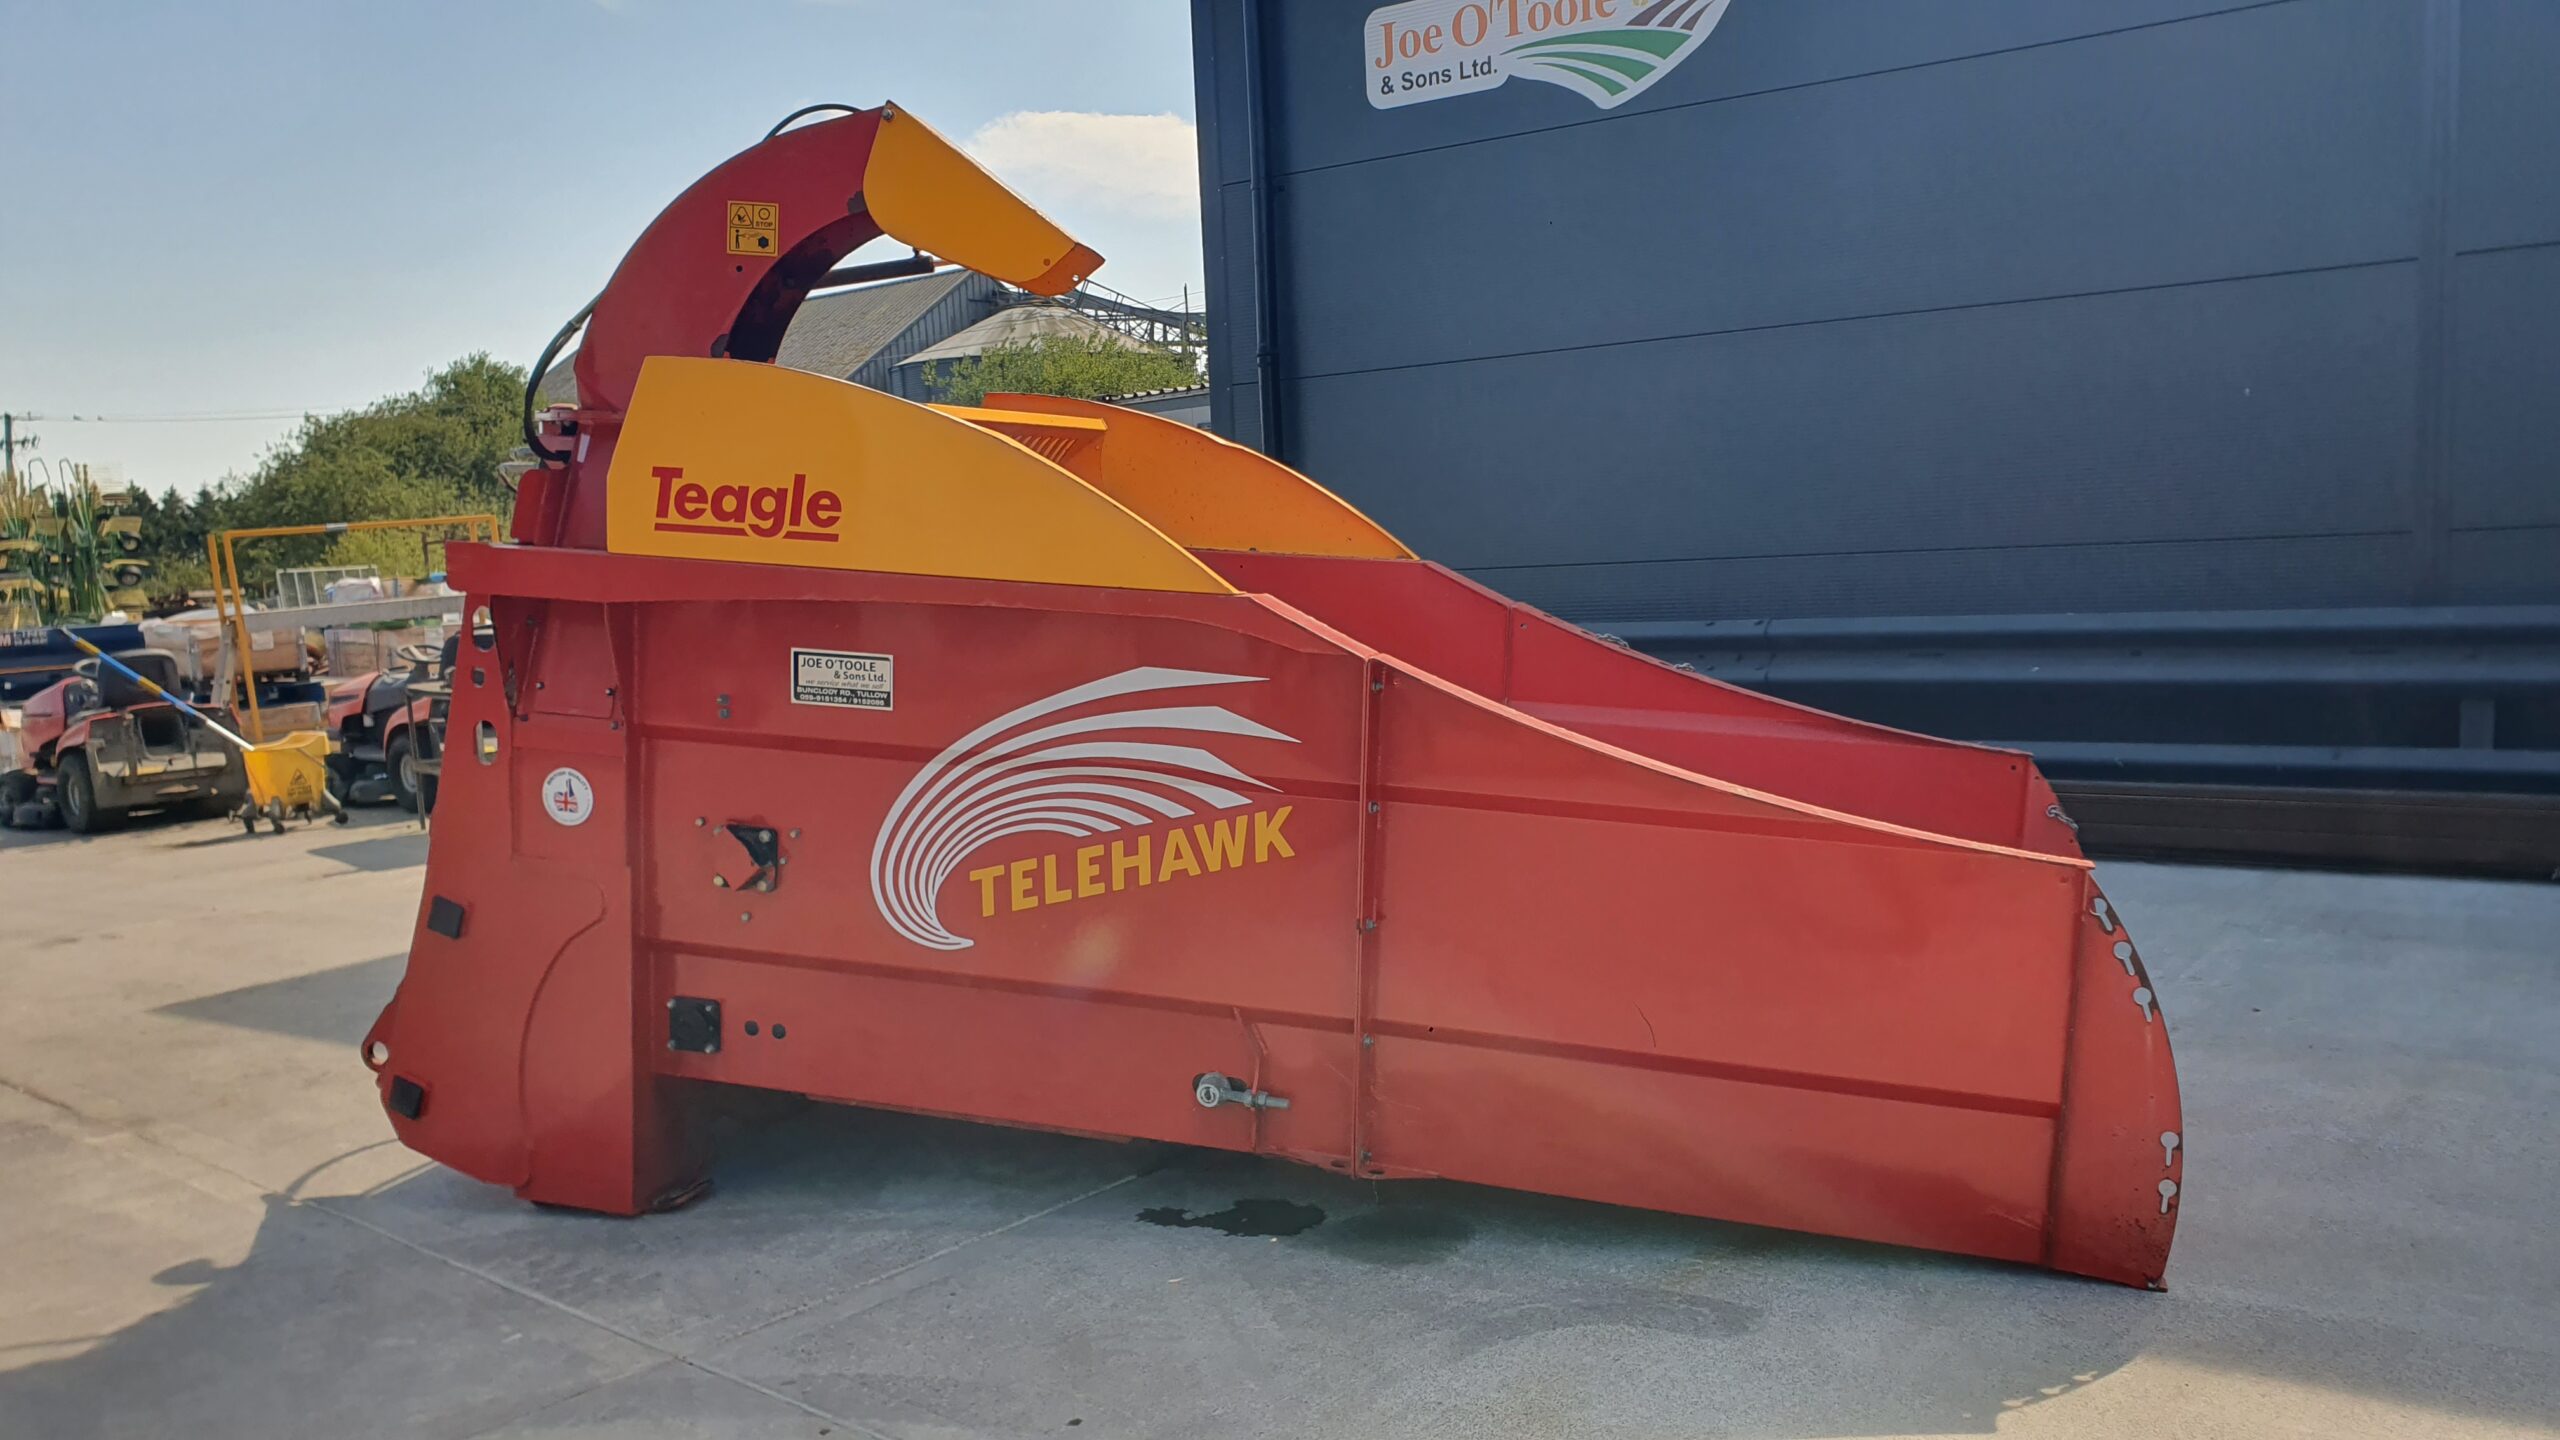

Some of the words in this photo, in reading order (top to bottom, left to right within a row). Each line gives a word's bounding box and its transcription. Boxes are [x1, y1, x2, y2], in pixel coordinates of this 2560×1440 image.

[1375, 21, 1443, 69] Joe
[1380, 75, 1394, 95] &
[1401, 66, 1452, 92] Sons
[1459, 55, 1498, 81] Ltd.
[652, 466, 842, 538] Teagle
[801, 657, 822, 668] JOE
[825, 658, 876, 672] O'TOOLE
[834, 671, 841, 680] &
[843, 672, 866, 681] Sons
[868, 673, 887, 683] Ltd.
[857, 691, 888, 699] TULLOW
[969, 805, 1295, 917] TELEHAWK
